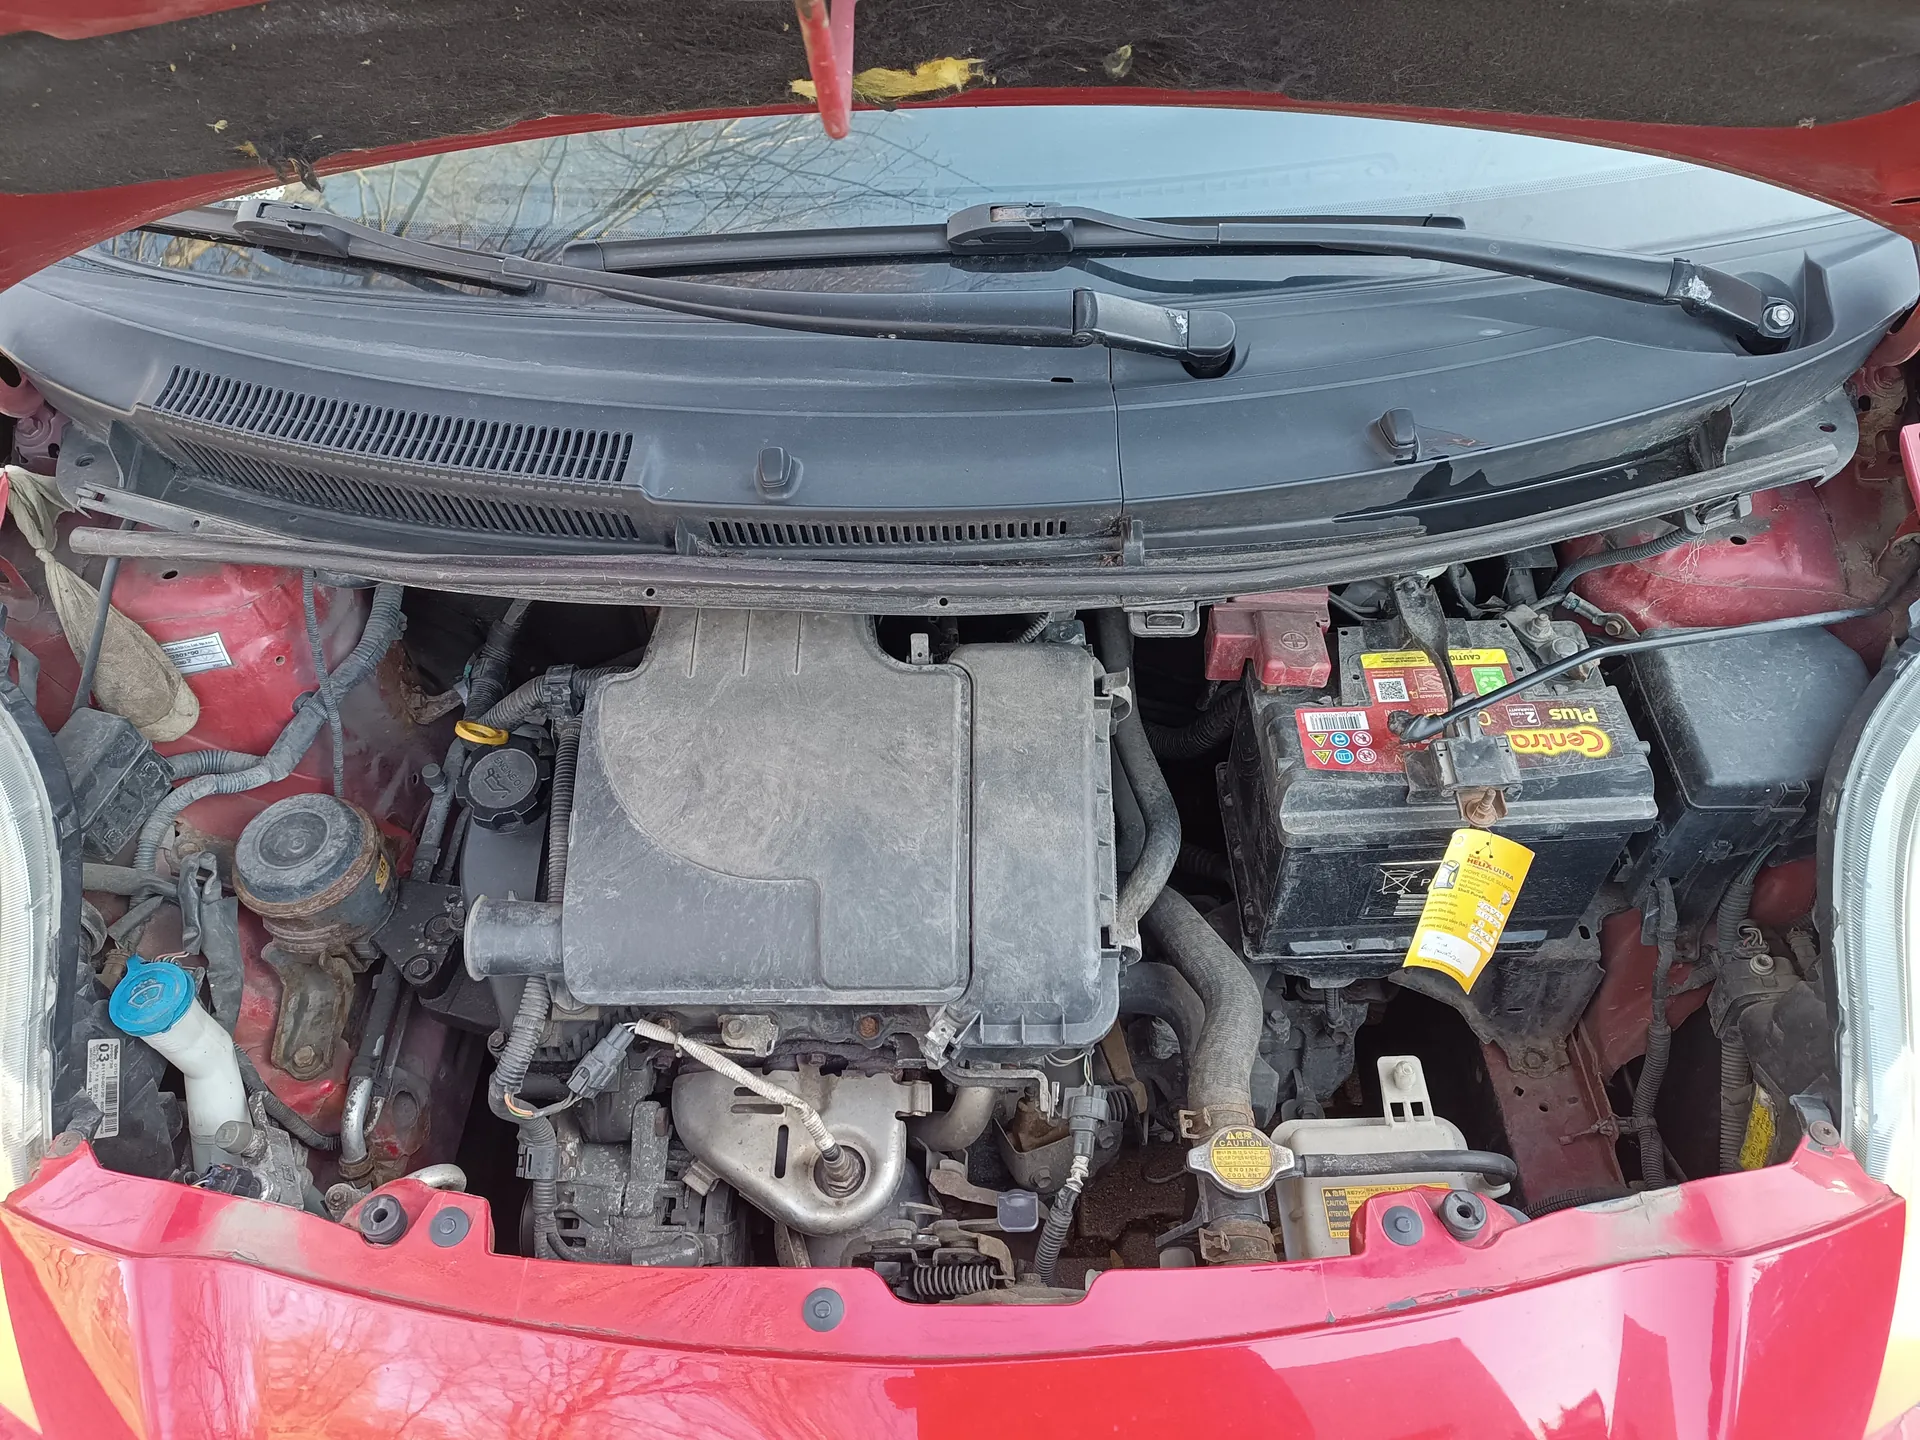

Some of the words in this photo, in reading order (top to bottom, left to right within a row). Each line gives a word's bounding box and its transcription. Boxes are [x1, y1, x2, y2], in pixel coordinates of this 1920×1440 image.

[1524, 711, 1537, 723] 2
[1548, 707, 1599, 723] Plus
[1511, 730, 1603, 753] Centra
[1467, 858, 1493, 871] HELIX
[1493, 867, 1514, 881] ULTRA
[98, 1043, 110, 1062] 03
